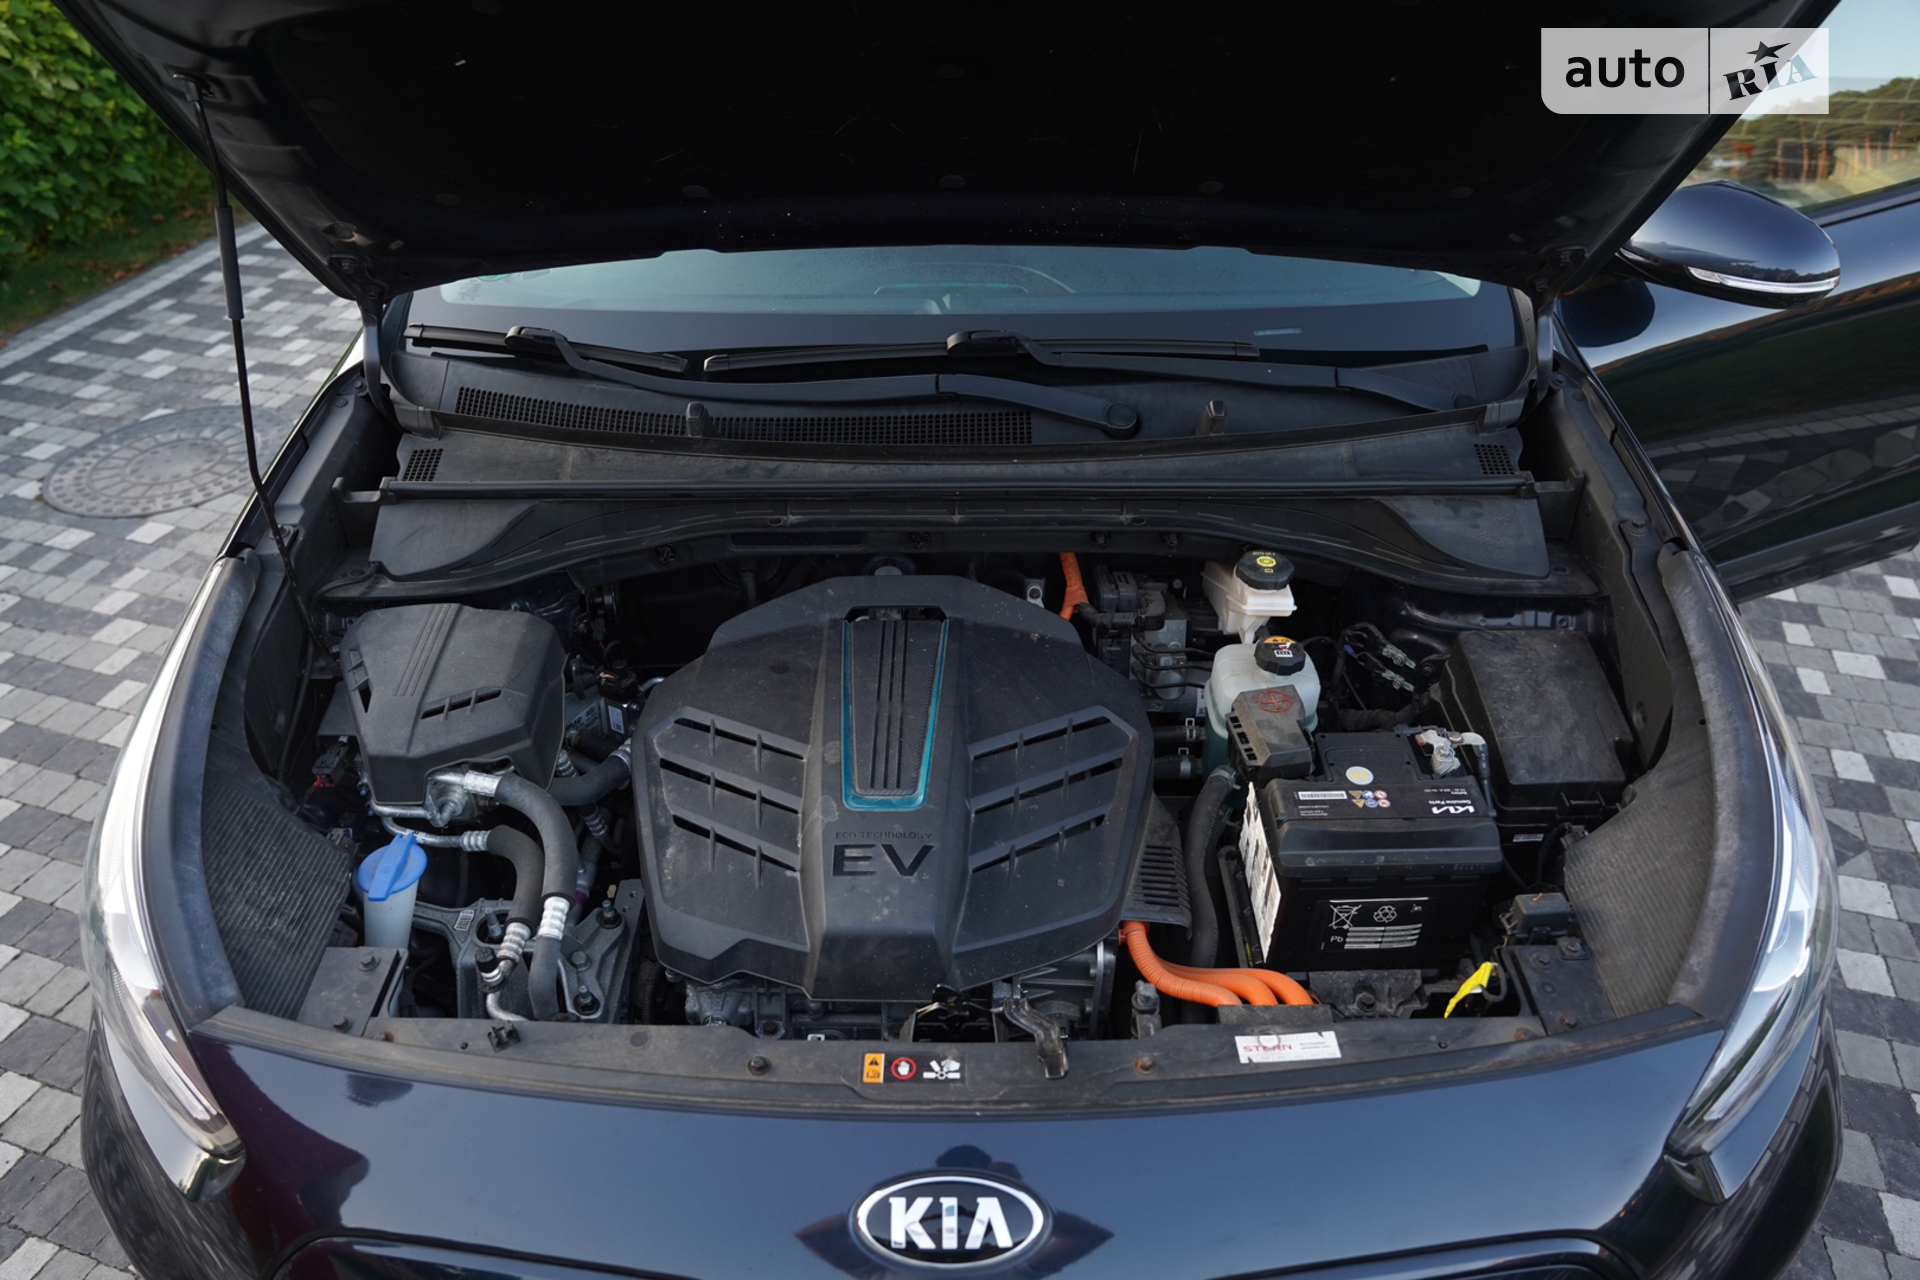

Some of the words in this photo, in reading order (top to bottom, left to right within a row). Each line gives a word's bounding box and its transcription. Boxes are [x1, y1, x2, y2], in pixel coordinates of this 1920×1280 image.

[836, 831, 857, 839] ECO
[832, 844, 935, 877] EV
[1330, 935, 1344, 943] Pb
[888, 1197, 1014, 1250] KIA
